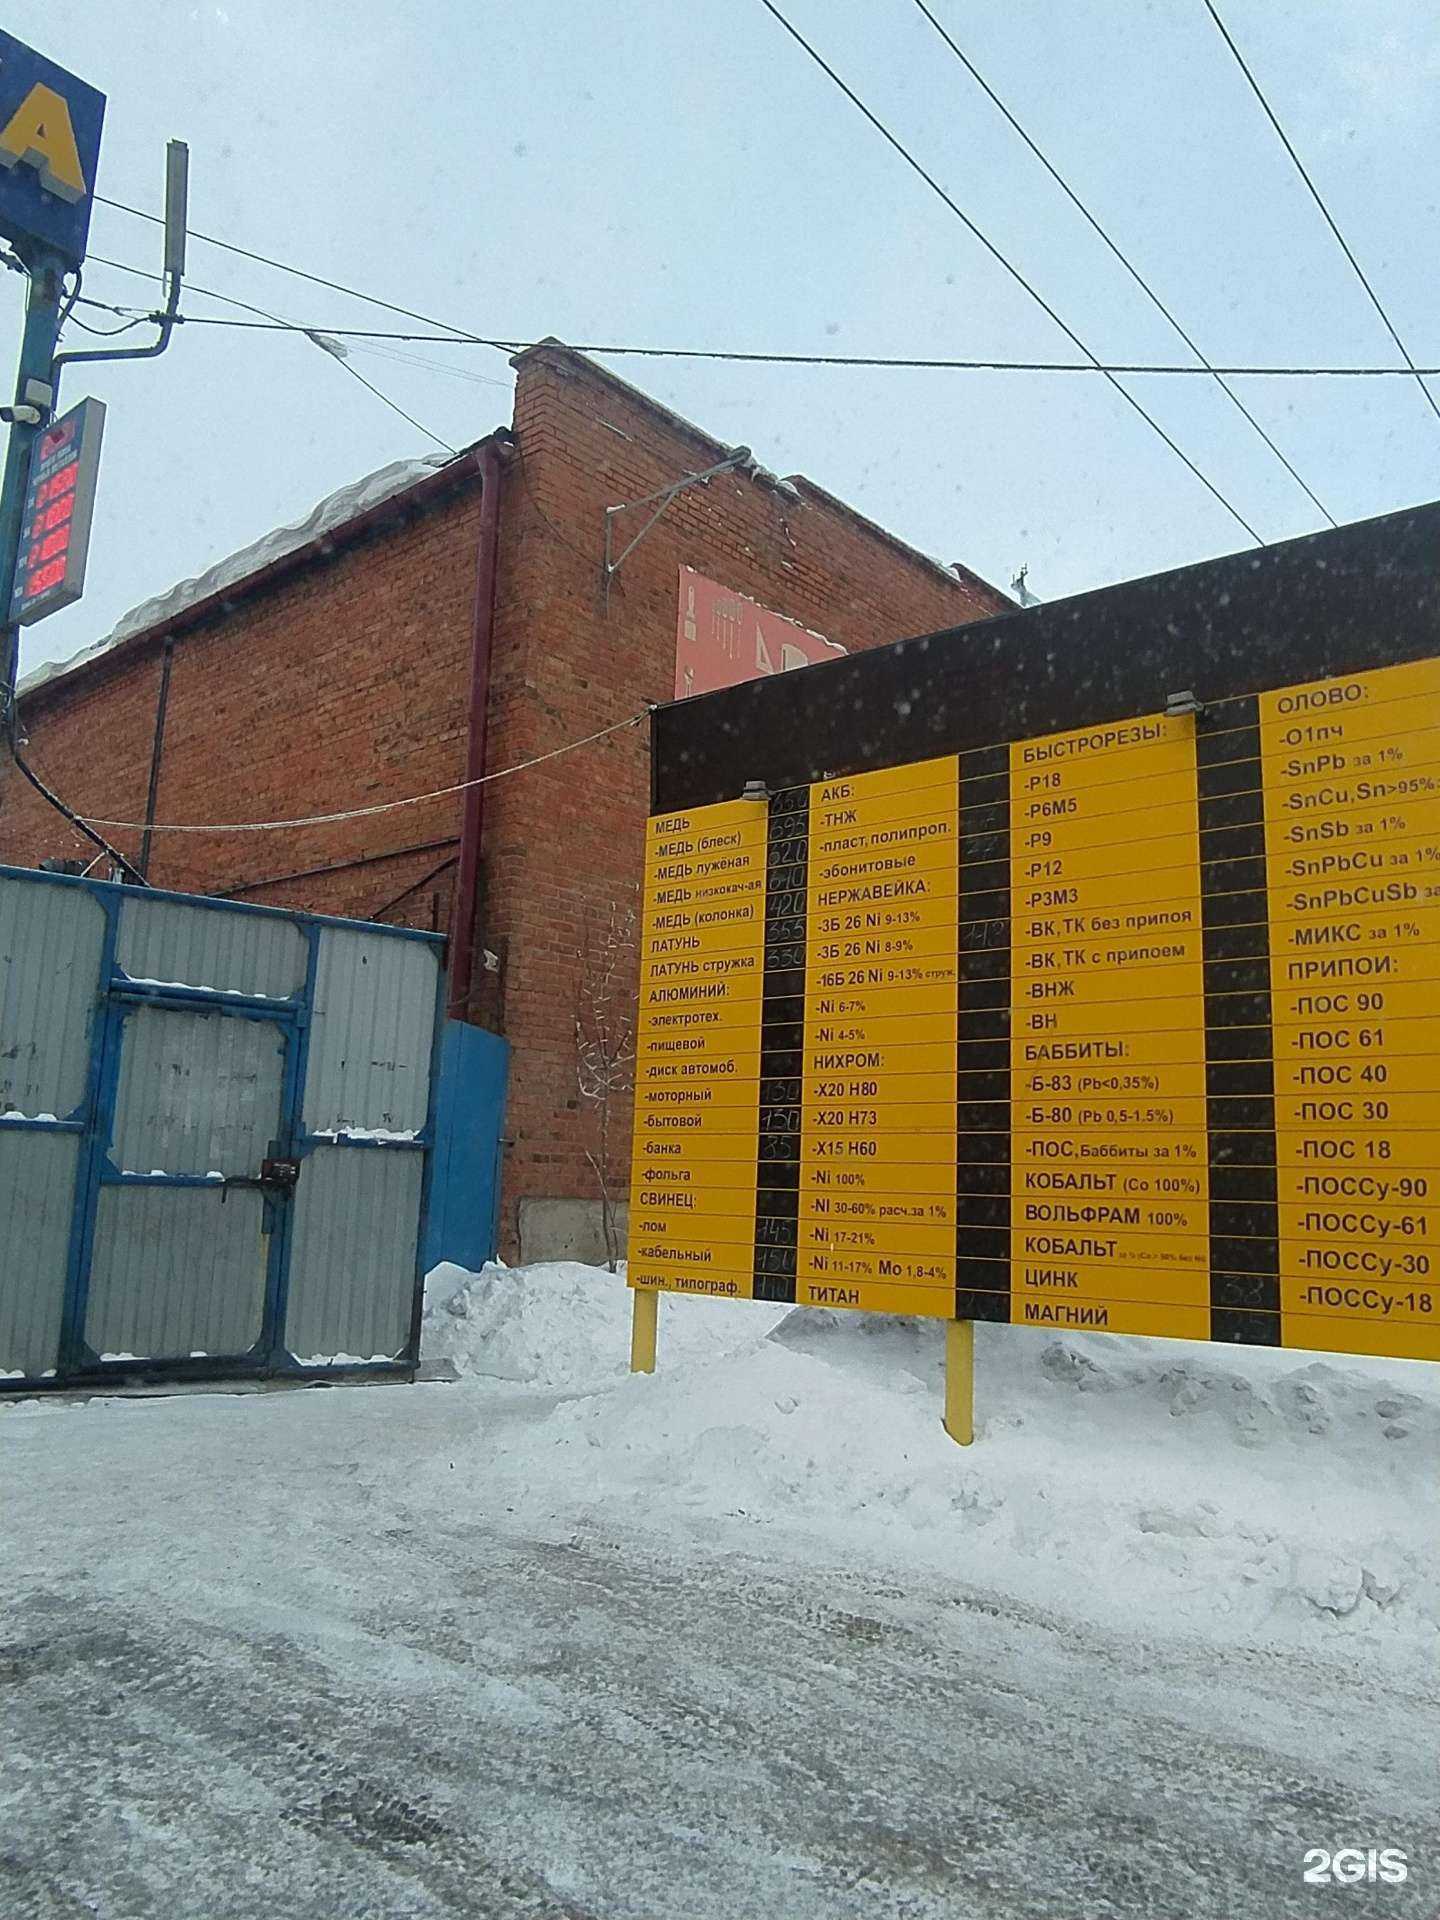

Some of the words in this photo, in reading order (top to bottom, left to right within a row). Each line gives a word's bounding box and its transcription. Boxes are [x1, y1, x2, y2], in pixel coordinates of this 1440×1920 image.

[1278, 683, 1368, 714] ОЛОВО:
[1024, 723, 1167, 763] БЫСТРОРЕЗЫ:
[1280, 754, 1345, 777] -SnPb
[1353, 752, 1371, 767] за
[1378, 747, 1402, 762] 1%
[1024, 773, 1060, 791] -Р18
[821, 786, 854, 802] АКБ:
[1024, 798, 1077, 818] -Р6М5
[656, 818, 690, 834] МЕДЬ
[820, 810, 857, 827] -ТНЖ
[871, 822, 952, 849] полипроп.
[1284, 820, 1349, 843] -SnSb
[1356, 820, 1373, 835] за
[1380, 816, 1406, 830] 1%
[654, 841, 694, 857] -МЕДЬ
[697, 832, 741, 852] (блеск)
[1025, 832, 1052, 848] -Р9
[654, 865, 692, 881] -МЕДЬ
[696, 855, 750, 876] лужёная
[819, 854, 916, 880] -эбонитовые
[1390, 854, 1408, 865] за
[1026, 860, 1062, 878] -Р12
[653, 888, 691, 904] -МЕДЬ
[818, 880, 930, 906] НЕРЖАВЕЙКА:
[1026, 889, 1078, 908] -Р3М3
[652, 914, 690, 930] -МЕДЬ
[694, 905, 754, 926] (колонка)
[844, 915, 861, 930] 26
[866, 912, 880, 926] Ni
[886, 911, 920, 926] 9-13%
[1092, 915, 1120, 931] без
[1126, 910, 1192, 929] припоя
[1288, 924, 1361, 946] -МИКС
[1368, 925, 1386, 940] за
[1394, 922, 1420, 937] 1%
[652, 937, 700, 953] ЛАТУНЬ
[844, 942, 861, 957] 26
[866, 940, 880, 954] Ni
[885, 939, 913, 953] 8-9%
[1106, 945, 1185, 962] припоем
[650, 962, 699, 978] ЛАТУНЬ
[702, 956, 754, 976] стружка
[848, 969, 864, 984] 26
[868, 968, 882, 982] Ni
[887, 968, 923, 981] 9-13%
[1288, 955, 1398, 980] ПРИПОИ:
[650, 983, 729, 1003] АЛЮМИНИЙ:
[1026, 980, 1074, 998] -ВНЖ
[816, 998, 834, 1014] -Ni
[839, 1000, 866, 1013] 6-7%
[1290, 995, 1348, 1015] -ПОС
[1357, 992, 1384, 1011] 90
[648, 1011, 722, 1027] -электротех.
[1026, 1014, 1058, 1029] -ВН
[815, 1027, 834, 1042] -Ni
[838, 1028, 866, 1041] 4-5%
[1292, 1031, 1350, 1049] -ПОС
[1359, 1029, 1384, 1046] 61
[648, 1037, 705, 1052] -пищевой
[1026, 1041, 1130, 1062] БАББИТЫ:
[646, 1062, 678, 1078] -диск
[681, 1061, 738, 1076] автомоб.
[814, 1052, 884, 1070] НИХРОМ:
[1293, 1066, 1352, 1084] -ПОС
[1360, 1065, 1387, 1083] 40
[1026, 1076, 1072, 1092] -Б-83
[644, 1088, 712, 1104] -моторный
[1026, 1108, 1072, 1124] -Б-80
[1294, 1102, 1353, 1120] -ПОС
[1363, 1102, 1388, 1120] 30
[644, 1115, 702, 1128] -бытовой
[642, 1142, 682, 1154] -банка
[1153, 1147, 1169, 1158] за
[1174, 1145, 1196, 1158] 1%
[1296, 1140, 1356, 1159] -ПОС
[1365, 1141, 1390, 1159] 18
[642, 1168, 691, 1182] -фольга
[812, 1170, 831, 1184] -Ni
[836, 1174, 865, 1186] 100%
[1026, 1172, 1116, 1191] КОБАЛЬТ
[1154, 1178, 1200, 1194] 100%)
[1296, 1176, 1428, 1200] -ПОССу-90
[640, 1192, 696, 1210] СВИНЕЦ:
[834, 1202, 876, 1215] 30-60%
[928, 1206, 946, 1218] 1%
[1026, 1204, 1140, 1224] ВОЛЬФРАМ
[1148, 1210, 1188, 1226] 100%
[639, 1220, 666, 1234] -лом
[1298, 1213, 1427, 1238] -ПОССу-61
[810, 1228, 829, 1242] -Ni
[834, 1231, 876, 1245] 17-21%
[638, 1244, 711, 1262] -кабельный
[1025, 1238, 1117, 1258] КОБАЛЬТ
[809, 1256, 828, 1272] -Ni
[832, 1260, 872, 1275] 11-17%
[1299, 1250, 1429, 1276] -ПОССу-30
[675, 1276, 742, 1294] типограф.
[1025, 1270, 1078, 1288] ЦИНК
[808, 1286, 859, 1304] ТИТАН
[1300, 1286, 1432, 1314] -ПОССу-18
[1025, 1304, 1108, 1326] МАГНИЙ
